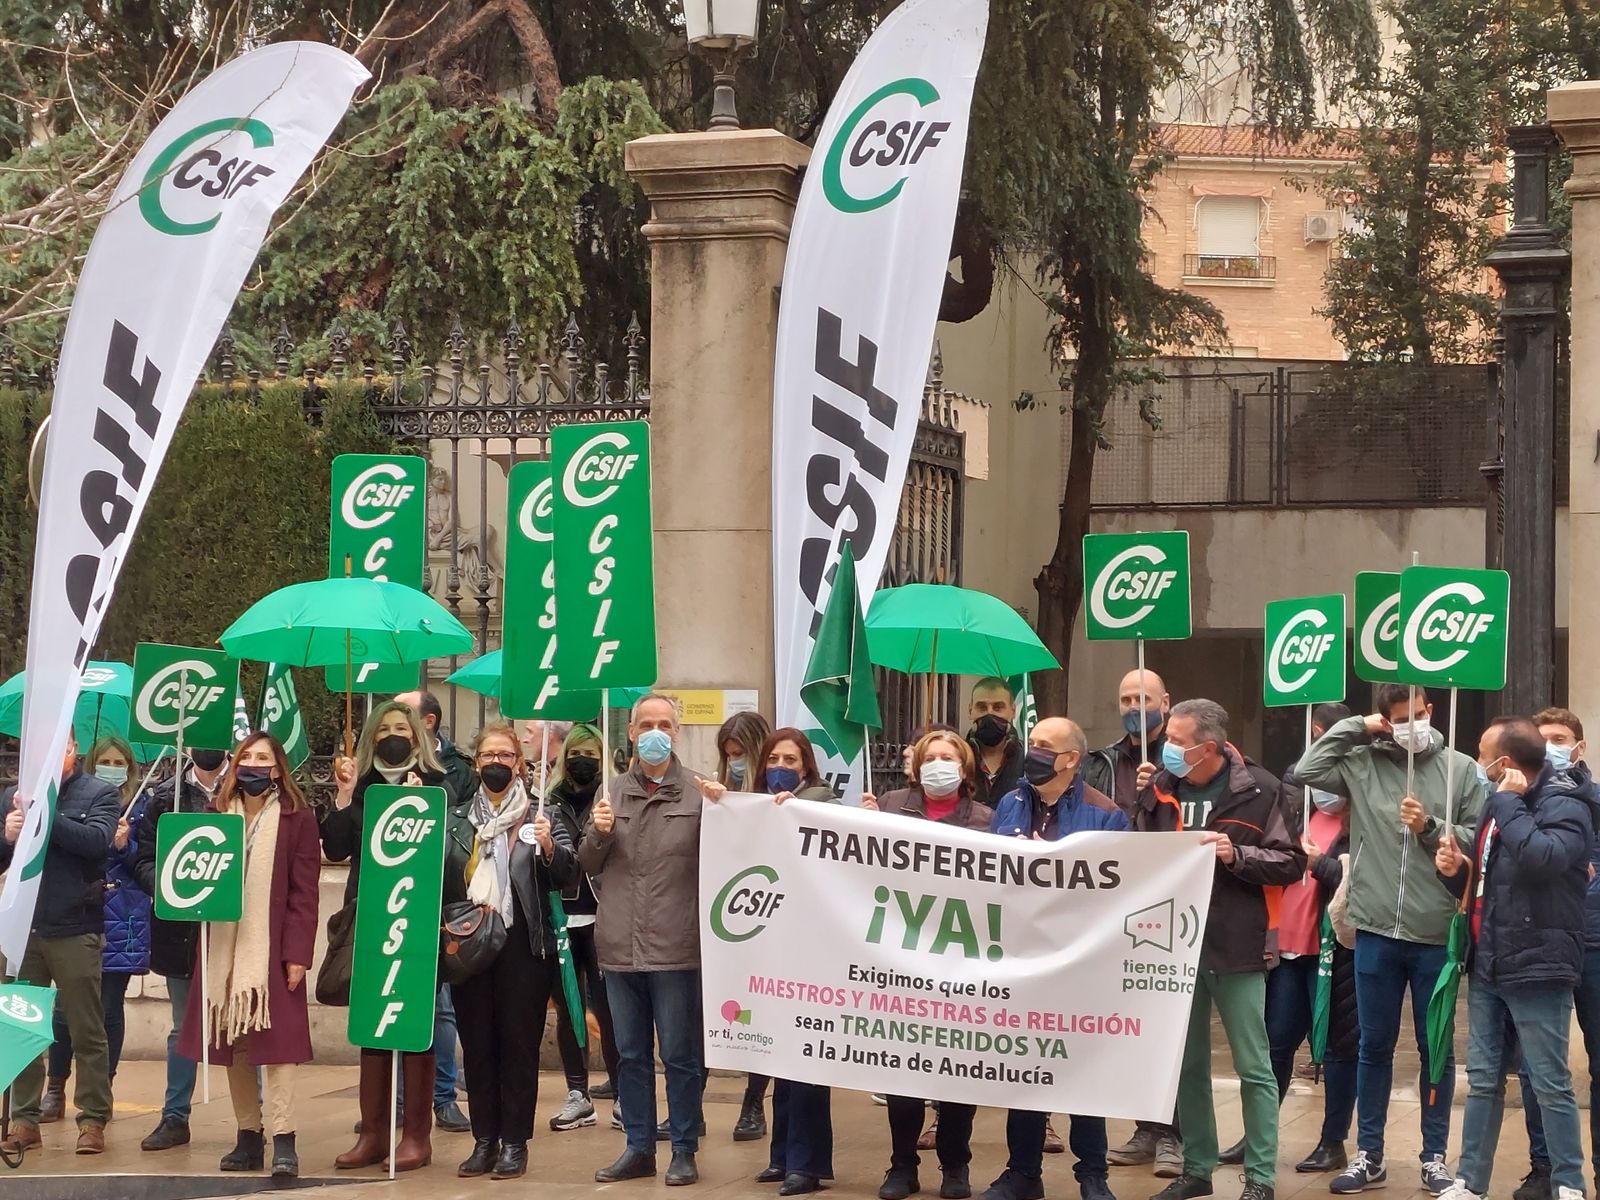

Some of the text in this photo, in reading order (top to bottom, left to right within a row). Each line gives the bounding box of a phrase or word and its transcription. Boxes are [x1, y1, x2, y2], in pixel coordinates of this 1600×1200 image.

[855, 119, 951, 168] CSIF
[173, 149, 276, 199] CSIF
[578, 454, 639, 482] CSIF
[356, 482, 415, 507] CSIF
[1107, 570, 1177, 601] CSIF
[1421, 608, 1495, 643] CSIF
[1281, 633, 1336, 665] CSIF
[154, 681, 226, 711] CSIF
[383, 816, 436, 843] CSIF
[175, 850, 235, 881] CSIF
[797, 826, 1121, 890] TRANSFERENCIAS
[727, 887, 785, 919] CSIF
[864, 884, 1004, 963] ¡YA!
[847, 964, 1011, 1000] Exigimos que los
[1122, 959, 1197, 978] tienes la
[748, 975, 1141, 1037] MAESTROS Y MAESTRAS de RELIGIÓN
[722, 1028, 734, 1042] ti,
[737, 1031, 774, 1047] contigo
[795, 1014, 1069, 1060] sean TRANSFERIDOS YA
[802, 1040, 1054, 1086] a la Junta de Andalucía
